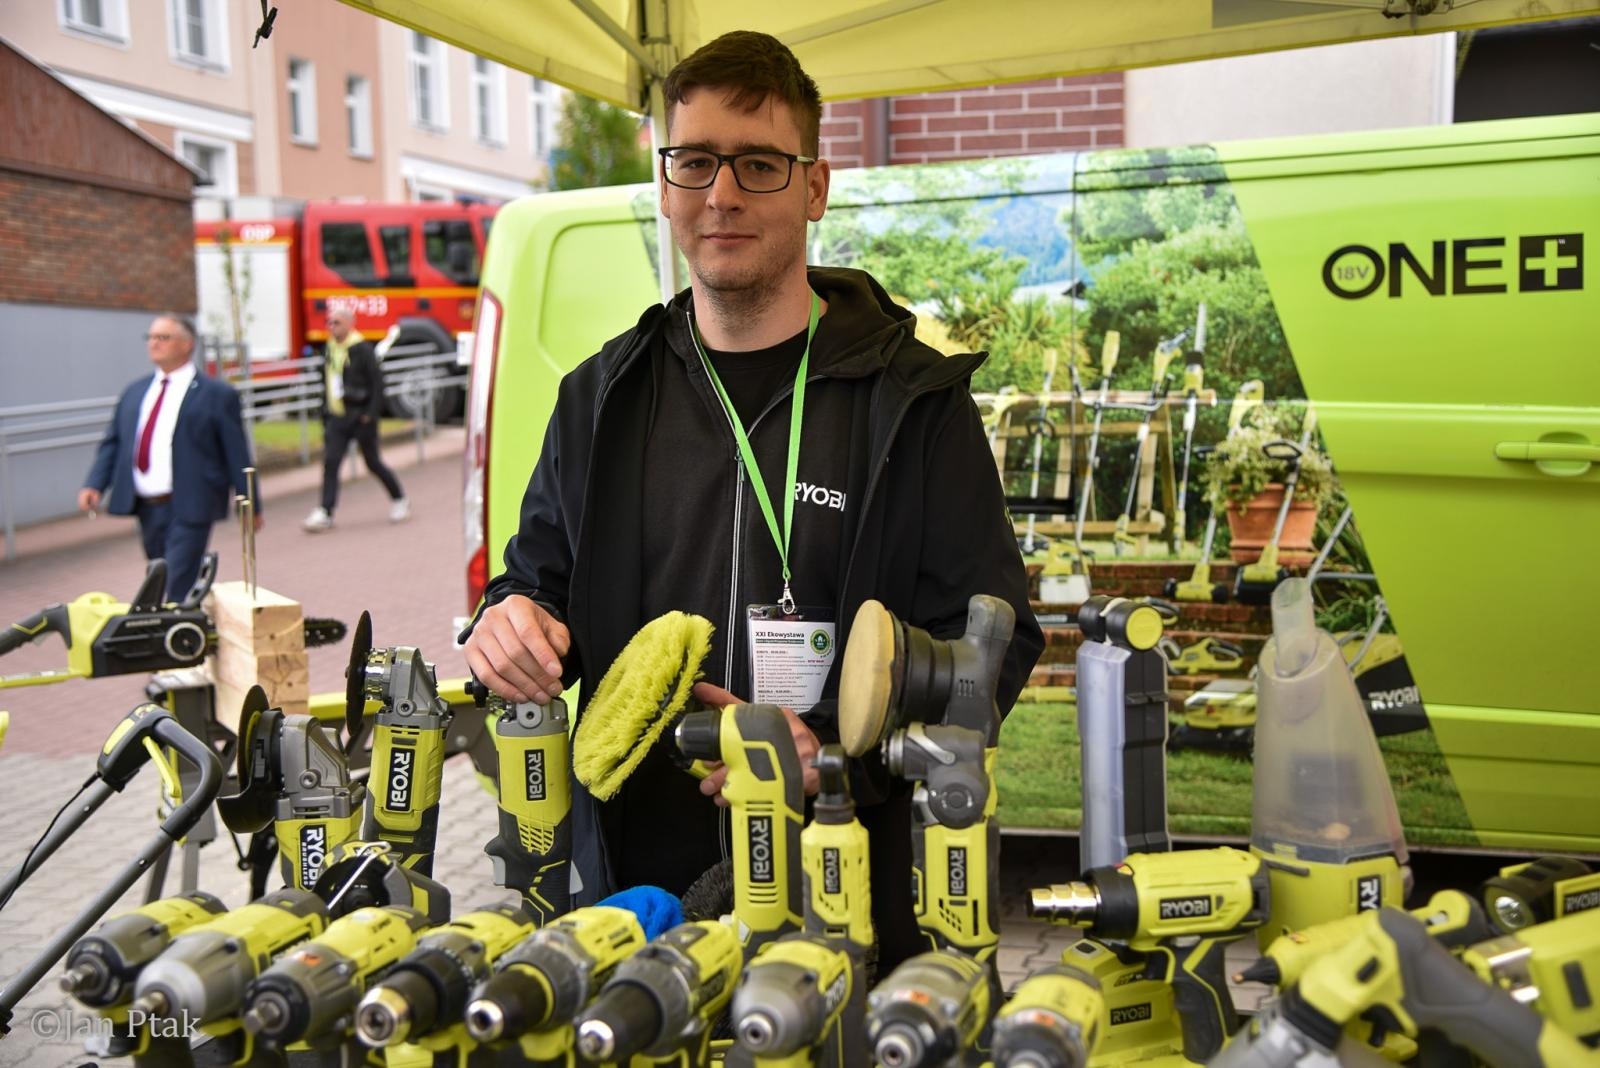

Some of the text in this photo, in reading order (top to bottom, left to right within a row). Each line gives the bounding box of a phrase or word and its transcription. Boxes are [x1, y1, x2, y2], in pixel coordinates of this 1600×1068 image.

[1337, 265, 1370, 281] 18V
[767, 631, 805, 639] Ekowystawa
[1368, 685, 1419, 711] RYOBI
[390, 751, 411, 807] RYOBI
[527, 752, 543, 799] RYOBI
[751, 818, 771, 880] RYOBI
[824, 849, 839, 892] RYOBI
[950, 849, 965, 895] RYOBI
[1161, 899, 1209, 918] RYOBI
[1112, 1004, 1150, 1024] RYOBI
